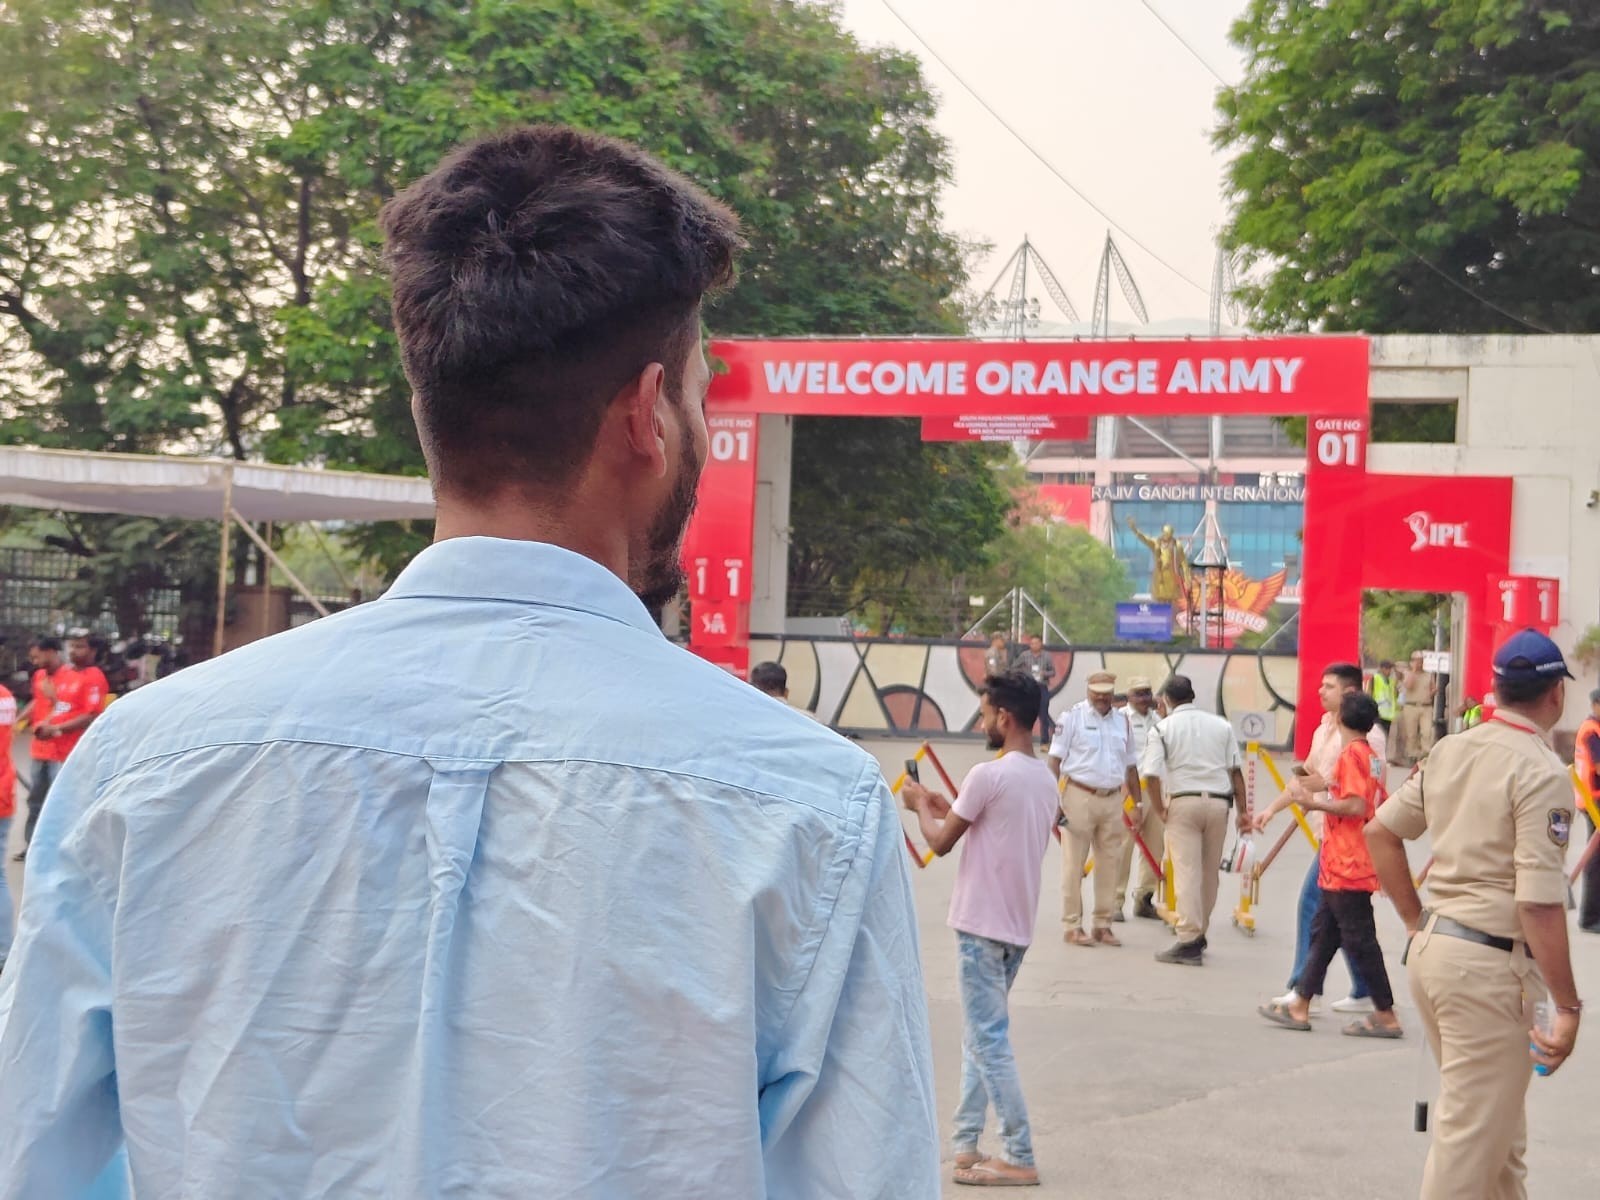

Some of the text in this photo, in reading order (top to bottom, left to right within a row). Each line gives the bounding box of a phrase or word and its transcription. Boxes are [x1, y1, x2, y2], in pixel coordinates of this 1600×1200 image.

[763, 357, 1304, 396] WELCOME ORANGE ARMY
[709, 418, 735, 428] GATE
[1315, 419, 1361, 431] GATE NO
[711, 431, 749, 461] 01
[1317, 432, 1358, 466] 01
[1091, 486, 1134, 500] RAJIV
[1138, 485, 1196, 500] GANDHI
[1430, 523, 1469, 547] IPL
[697, 566, 705, 594] 1
[727, 568, 738, 596] 1
[1501, 590, 1513, 622] 1
[1539, 590, 1549, 621] 1
